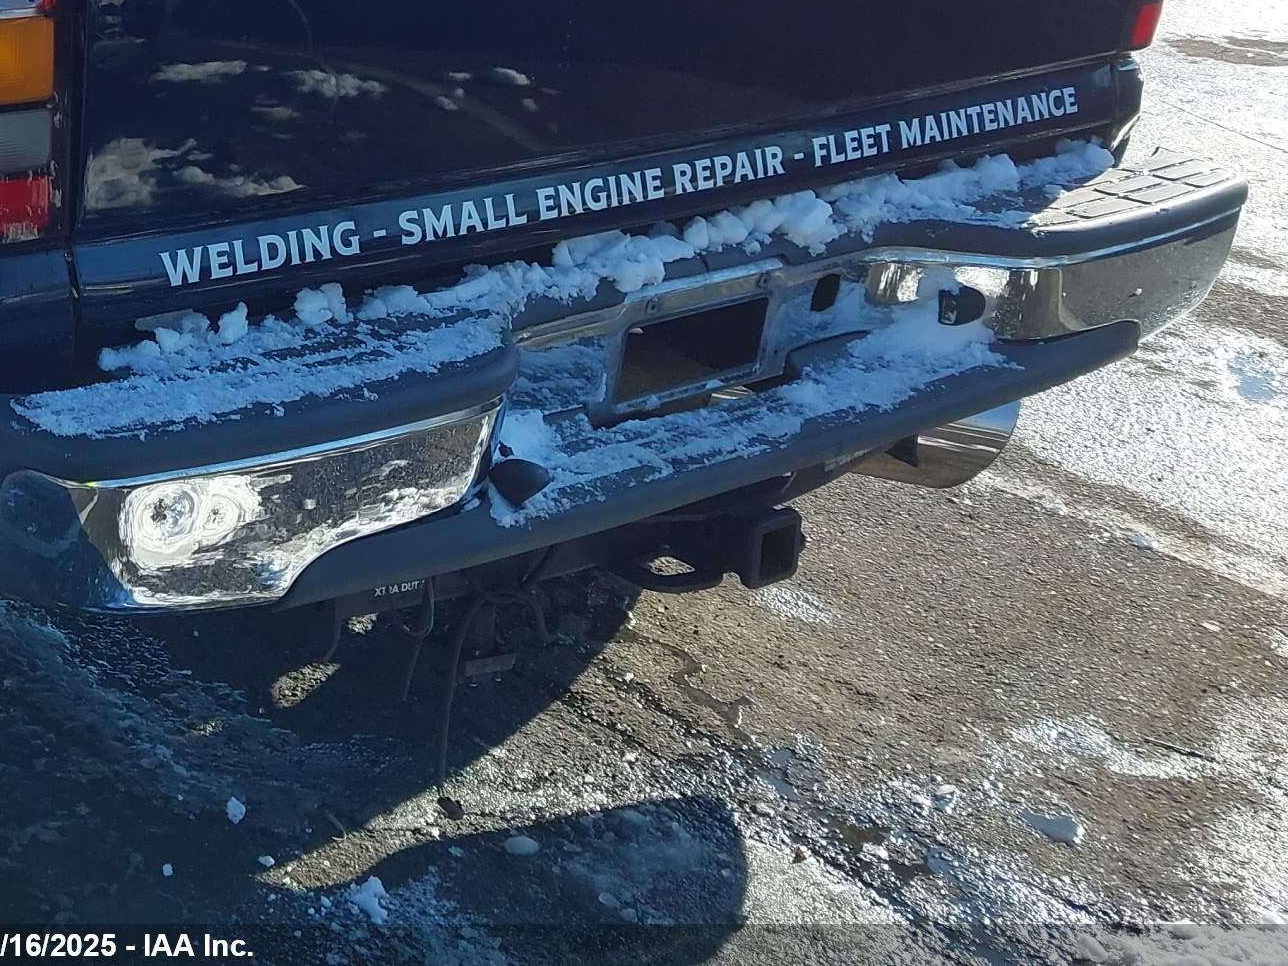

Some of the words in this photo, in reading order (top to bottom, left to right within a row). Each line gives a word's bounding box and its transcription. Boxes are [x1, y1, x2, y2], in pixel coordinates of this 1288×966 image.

[159, 220, 361, 287] WELDING
[399, 192, 528, 245] SMALL
[535, 167, 666, 221] ENGINE
[672, 146, 786, 195] REPAIR
[812, 123, 893, 167] FLEET
[899, 86, 1079, 149] MAINTENANCE
